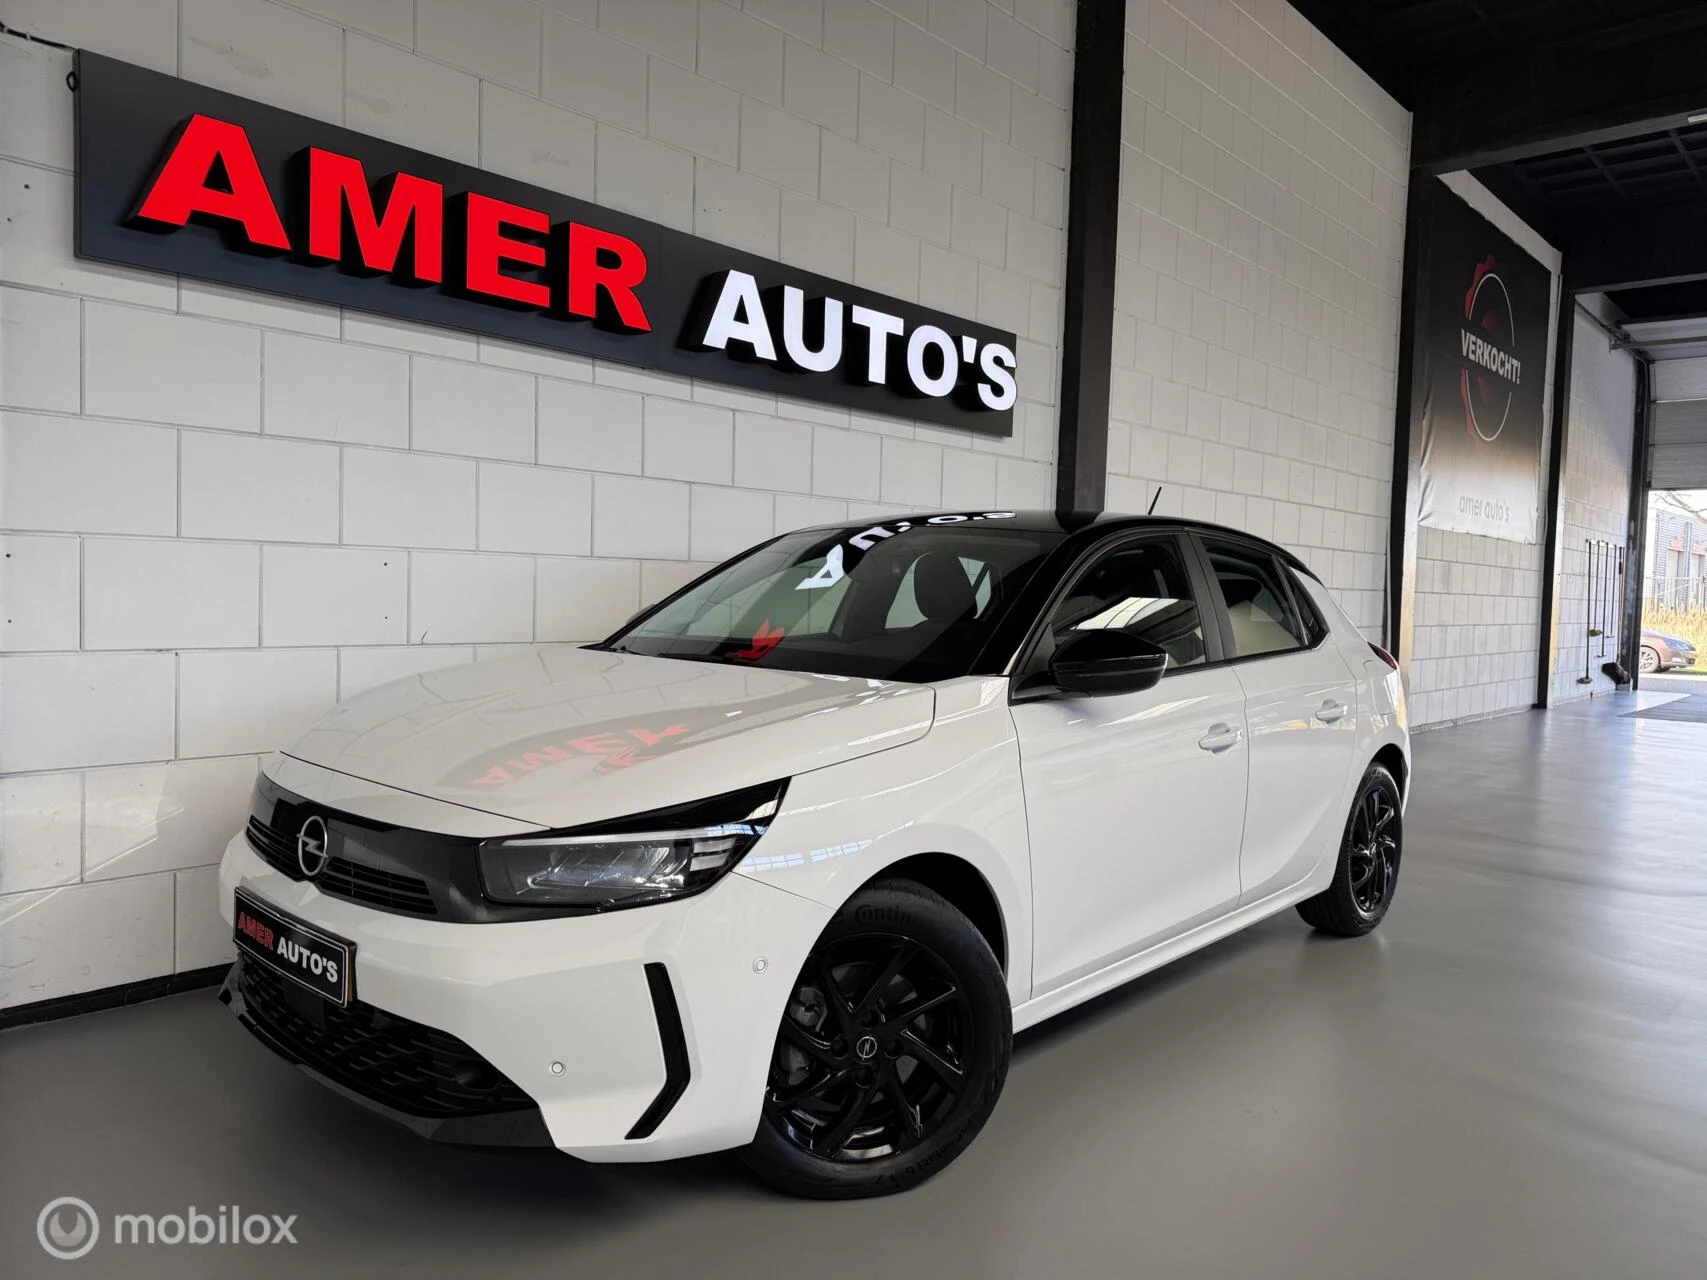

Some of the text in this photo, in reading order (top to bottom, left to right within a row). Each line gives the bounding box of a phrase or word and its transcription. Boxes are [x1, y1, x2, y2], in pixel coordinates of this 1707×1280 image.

[133, 113, 1017, 411] AMER AUTO'S
[1461, 328, 1520, 385] VERKOCHT!
[1459, 496, 1510, 523] amer auto's
[237, 911, 338, 984] AMER AUTO'S
